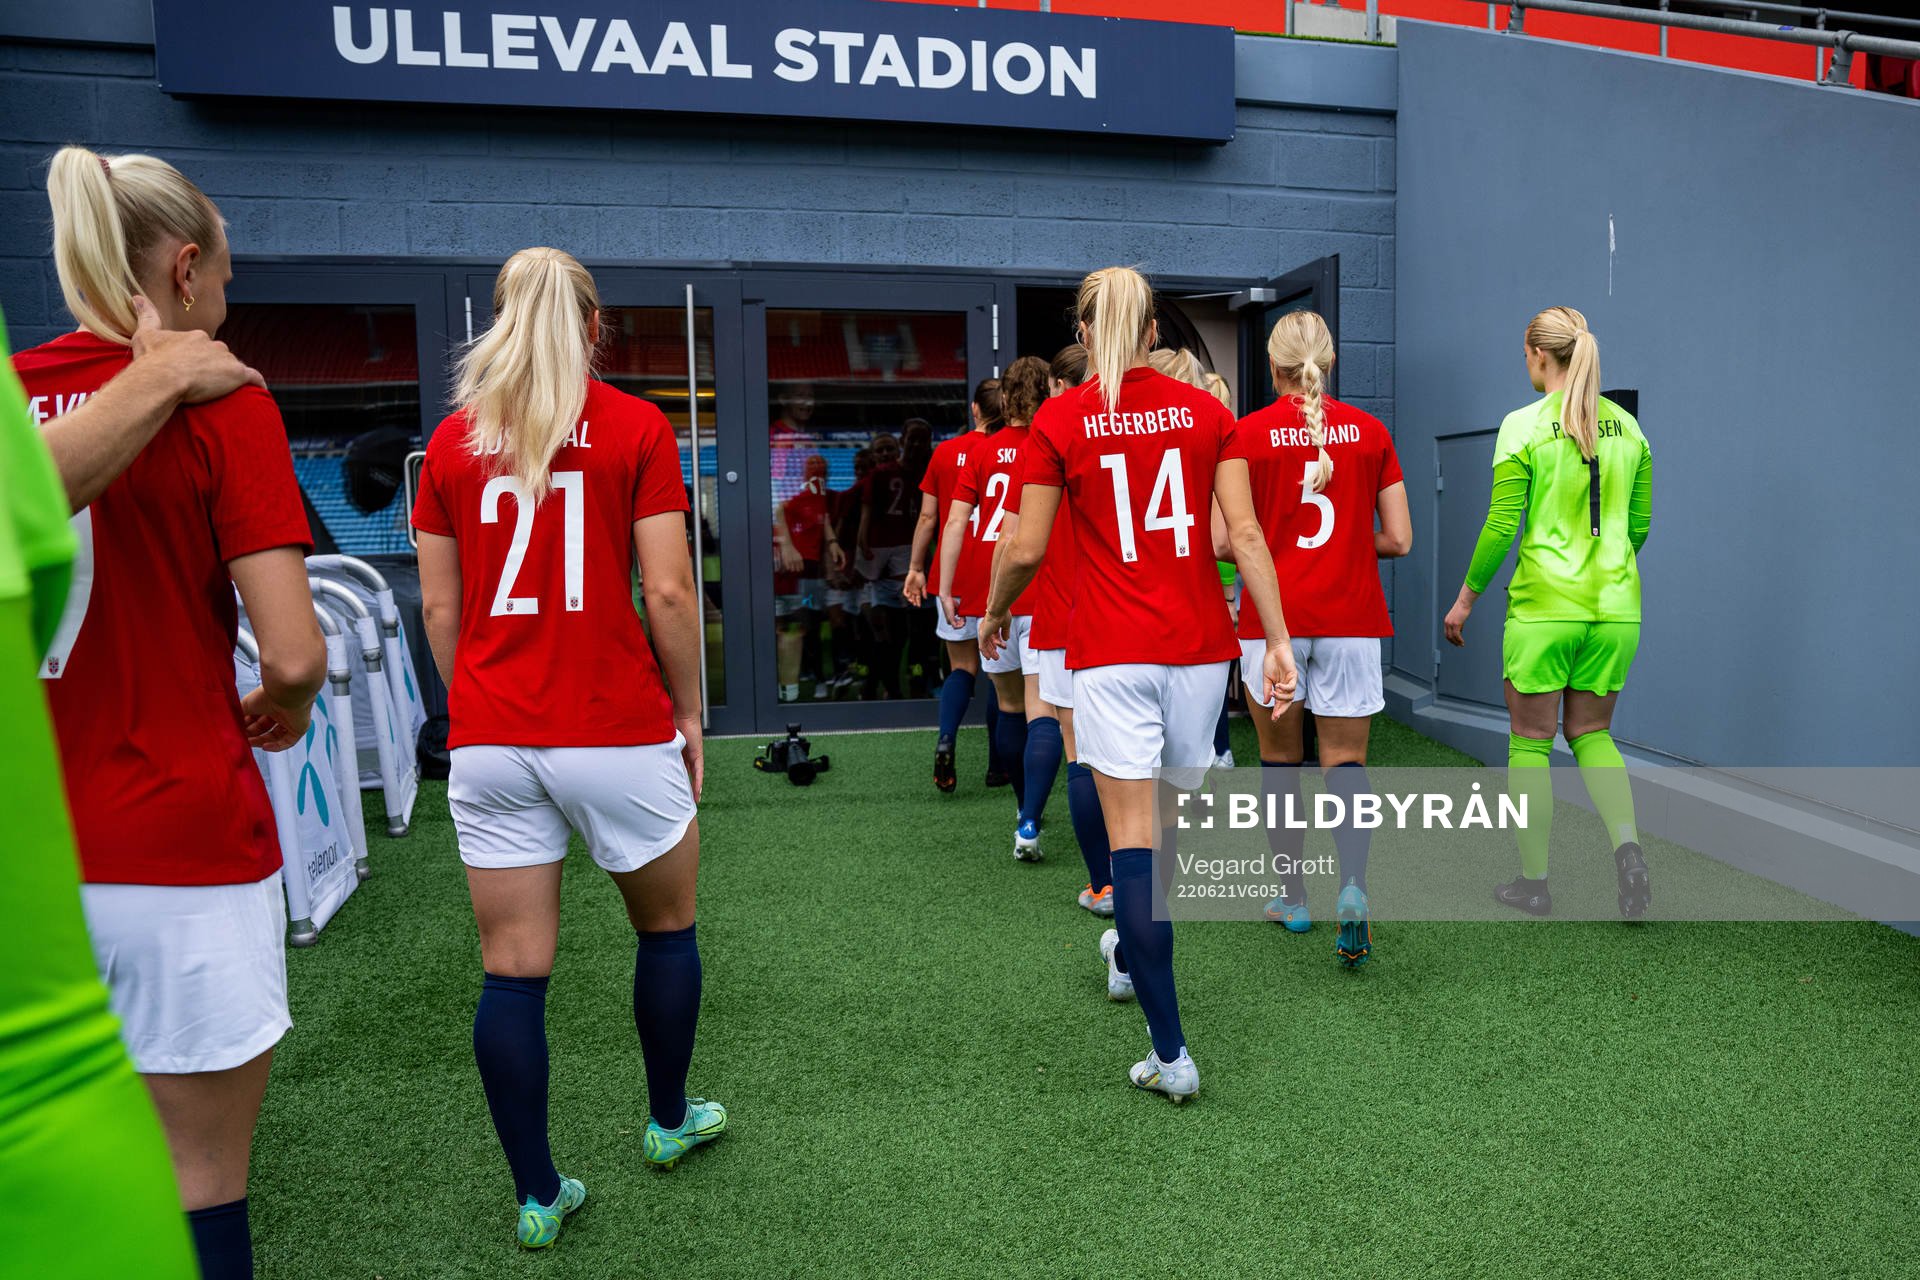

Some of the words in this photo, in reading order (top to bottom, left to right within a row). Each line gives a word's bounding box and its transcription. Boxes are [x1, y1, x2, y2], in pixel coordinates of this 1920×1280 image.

[333, 6, 753, 79] ULLEVAAL
[772, 28, 1097, 99] STADION
[1083, 407, 1194, 439] HEGERBERG
[1099, 447, 1195, 563] 14
[1296, 460, 1335, 549] 5
[1581, 455, 1600, 537] 1
[480, 471, 584, 617] 21
[308, 841, 338, 881] telenor
